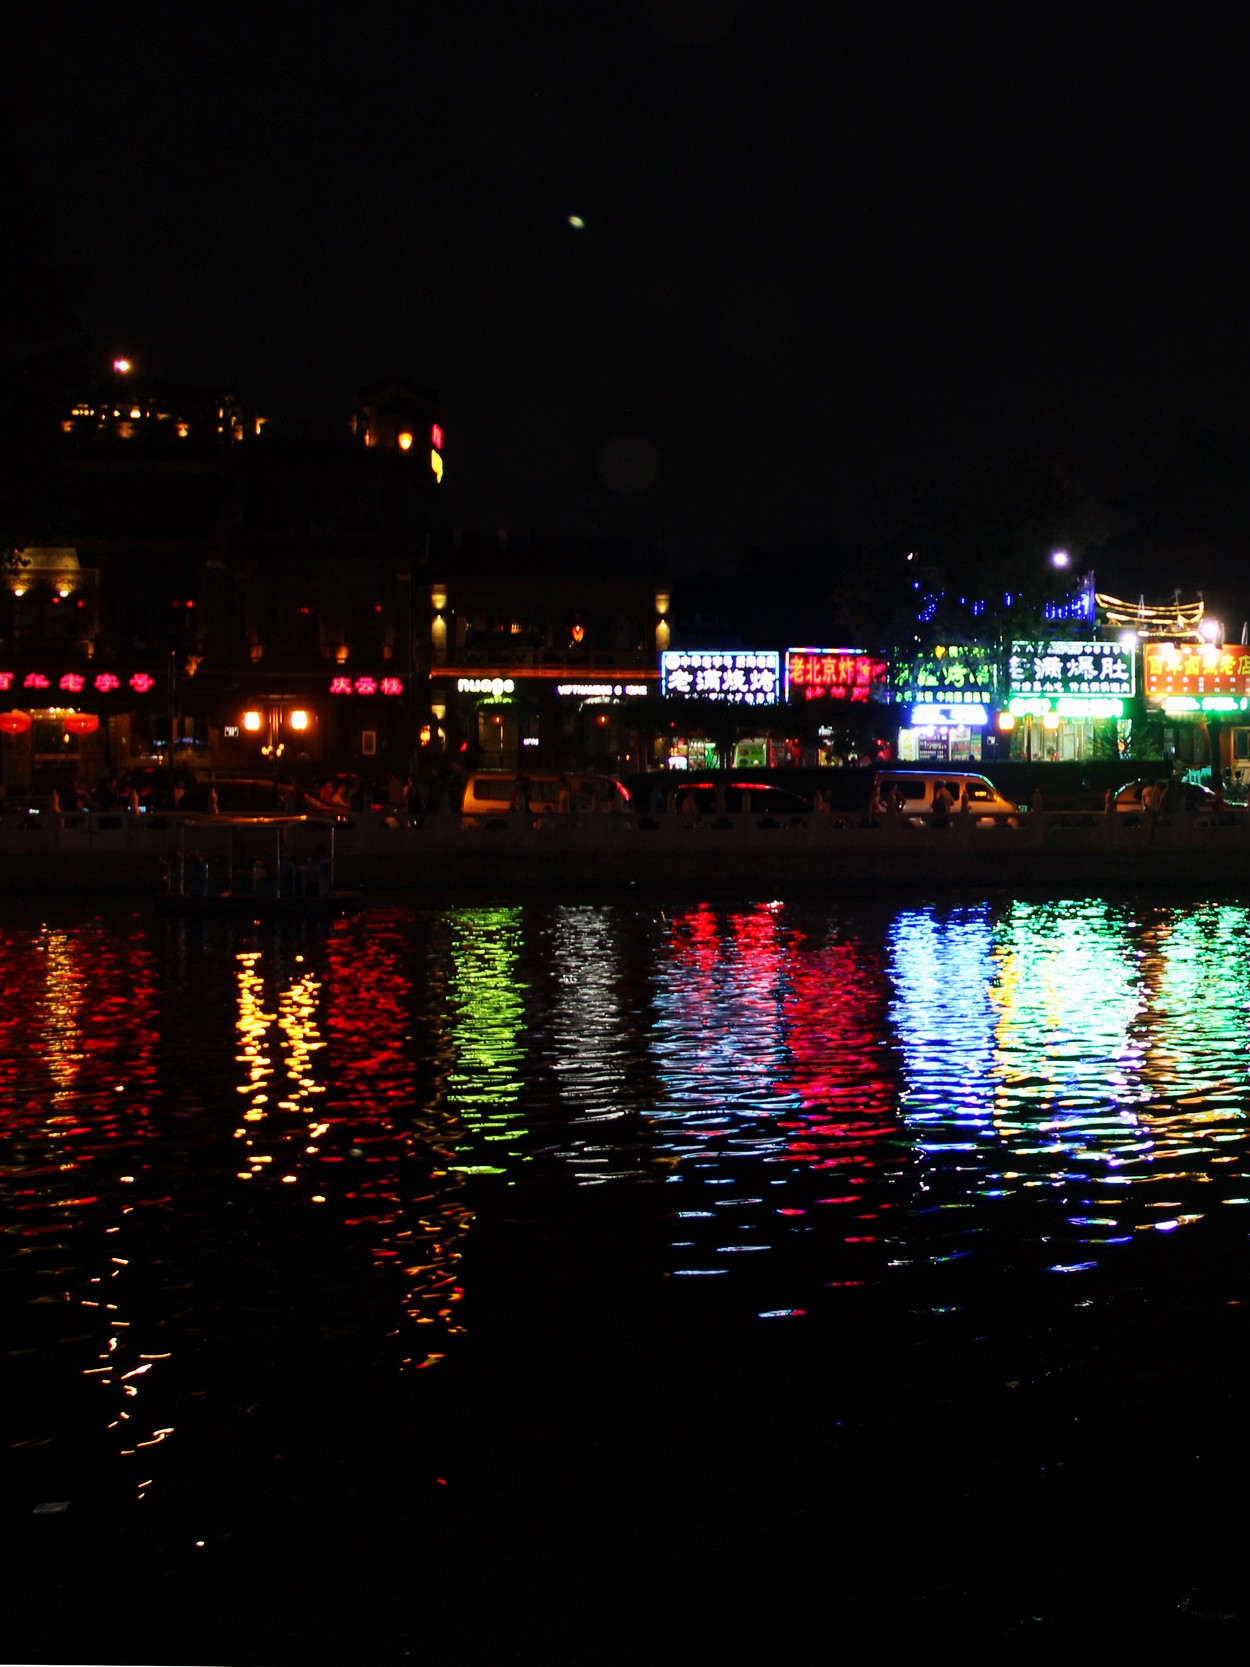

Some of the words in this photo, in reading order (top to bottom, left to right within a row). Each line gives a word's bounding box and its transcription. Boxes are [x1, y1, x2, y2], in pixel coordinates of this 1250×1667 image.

[1008, 655, 1130, 680] 老满爆肚
[329, 676, 404, 696] 庆云楼
[457, 677, 515, 696] nuage
[667, 668, 776, 692] 老满烧烤
